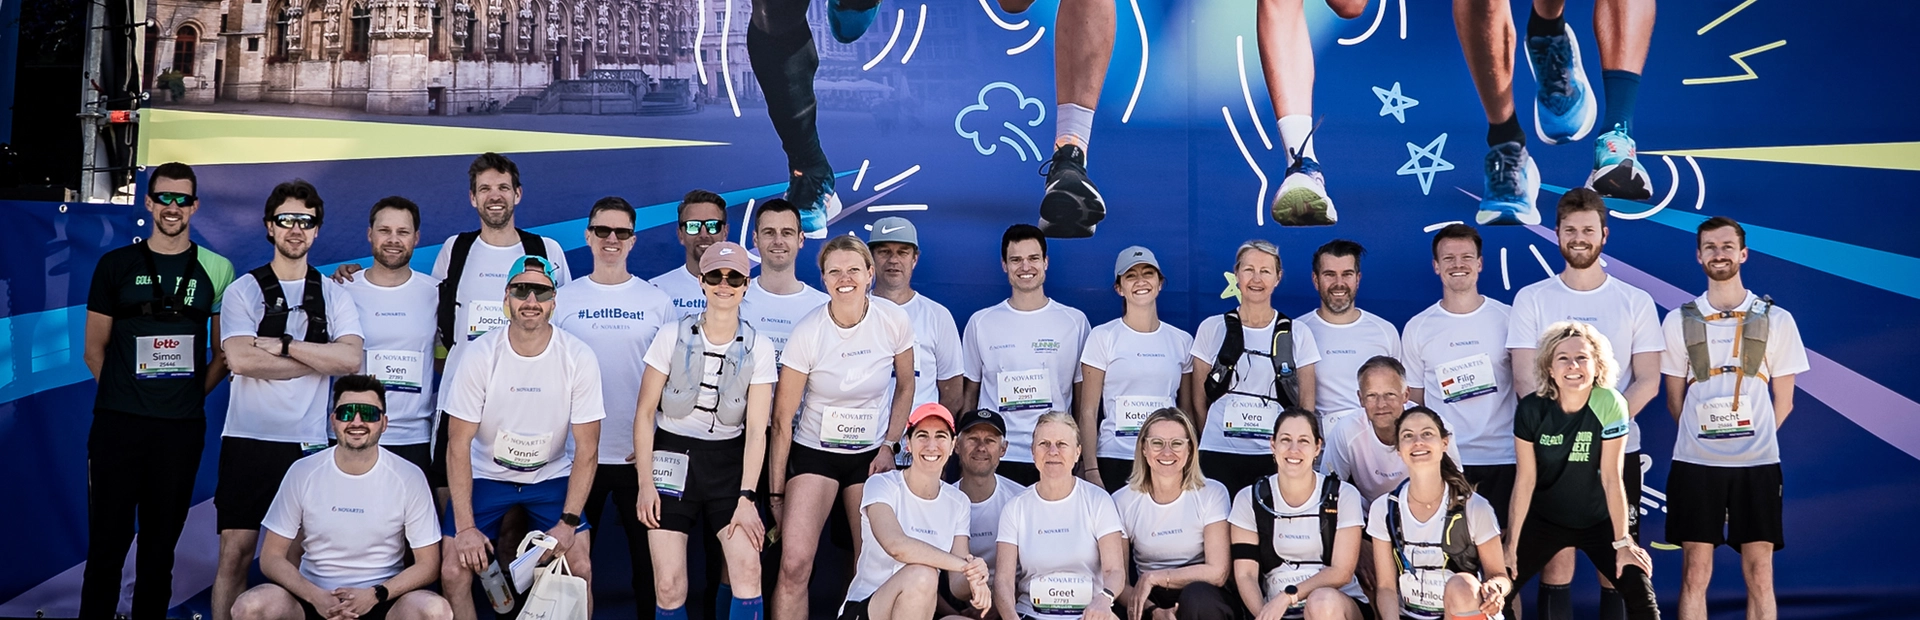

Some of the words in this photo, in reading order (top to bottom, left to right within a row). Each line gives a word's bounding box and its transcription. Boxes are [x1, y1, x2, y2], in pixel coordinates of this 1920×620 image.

[578, 308, 644, 320] #LetItBeat!
[153, 338, 180, 349] Lotto
[152, 352, 182, 361] Simon
[382, 354, 417, 362] NOVARTIS
[847, 349, 872, 357] NOVARTIS
[385, 365, 407, 374] Sven
[1449, 360, 1484, 373] NOVARTIS
[1011, 374, 1044, 382] NOVARTIS
[1456, 373, 1476, 385] Filip
[1013, 385, 1037, 395] Kevin
[1241, 412, 1263, 422] Vera
[1710, 413, 1740, 423] Brecht
[837, 424, 866, 434] Corine
[511, 438, 546, 447] NOVARTIS
[507, 446, 540, 458] Yannic
[652, 468, 673, 477] auni
[1047, 576, 1085, 584] NOVARTIS
[1048, 588, 1075, 598] Greet
